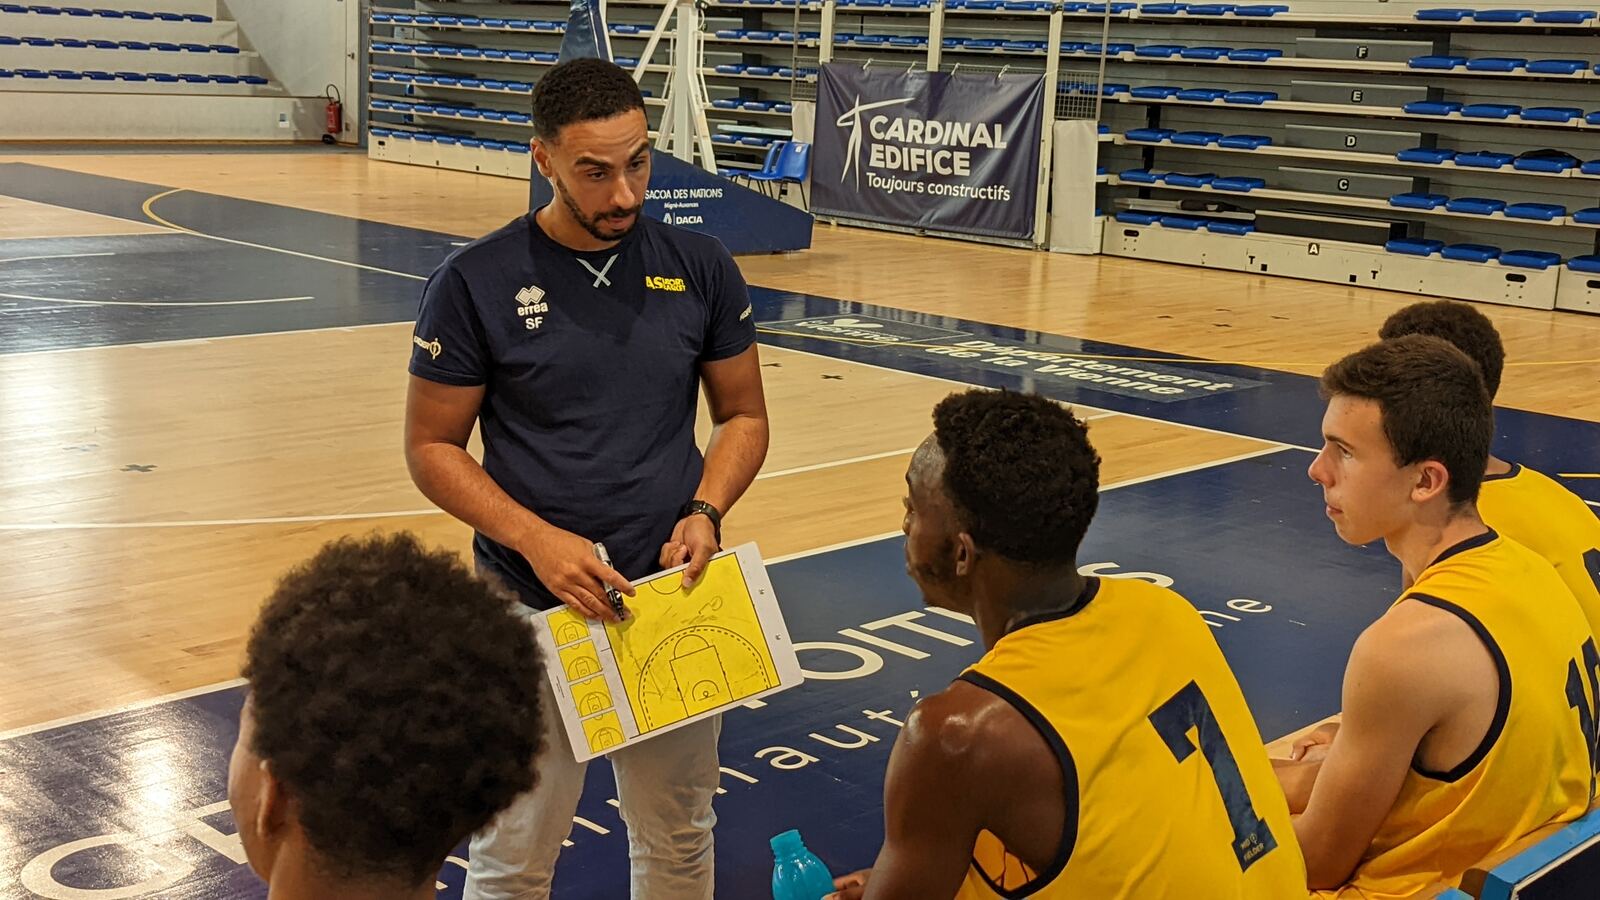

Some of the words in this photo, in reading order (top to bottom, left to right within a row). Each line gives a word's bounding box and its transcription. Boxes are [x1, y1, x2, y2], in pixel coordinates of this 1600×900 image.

[1352, 90, 1362, 102] E
[869, 115, 1008, 149] CARDINAL
[1346, 135, 1356, 147] D
[869, 143, 970, 176] EDIFICE
[866, 172, 924, 194] Toujours
[927, 182, 1011, 201] constructifs
[1338, 178, 1349, 190] C
[645, 189, 672, 200] SACOA
[673, 189, 688, 199] DES
[690, 188, 723, 198] NATIONS
[676, 215, 703, 225] DACIA
[1308, 243, 1320, 255] A
[1248, 255, 1256, 265] T
[1370, 270, 1379, 280] T
[525, 316, 544, 330] SF
[924, 347, 982, 358] de
[980, 356, 1029, 367] la
[1033, 364, 1185, 395] Vienne
[954, 340, 1234, 391] Département
[1147, 679, 1279, 873] 7
